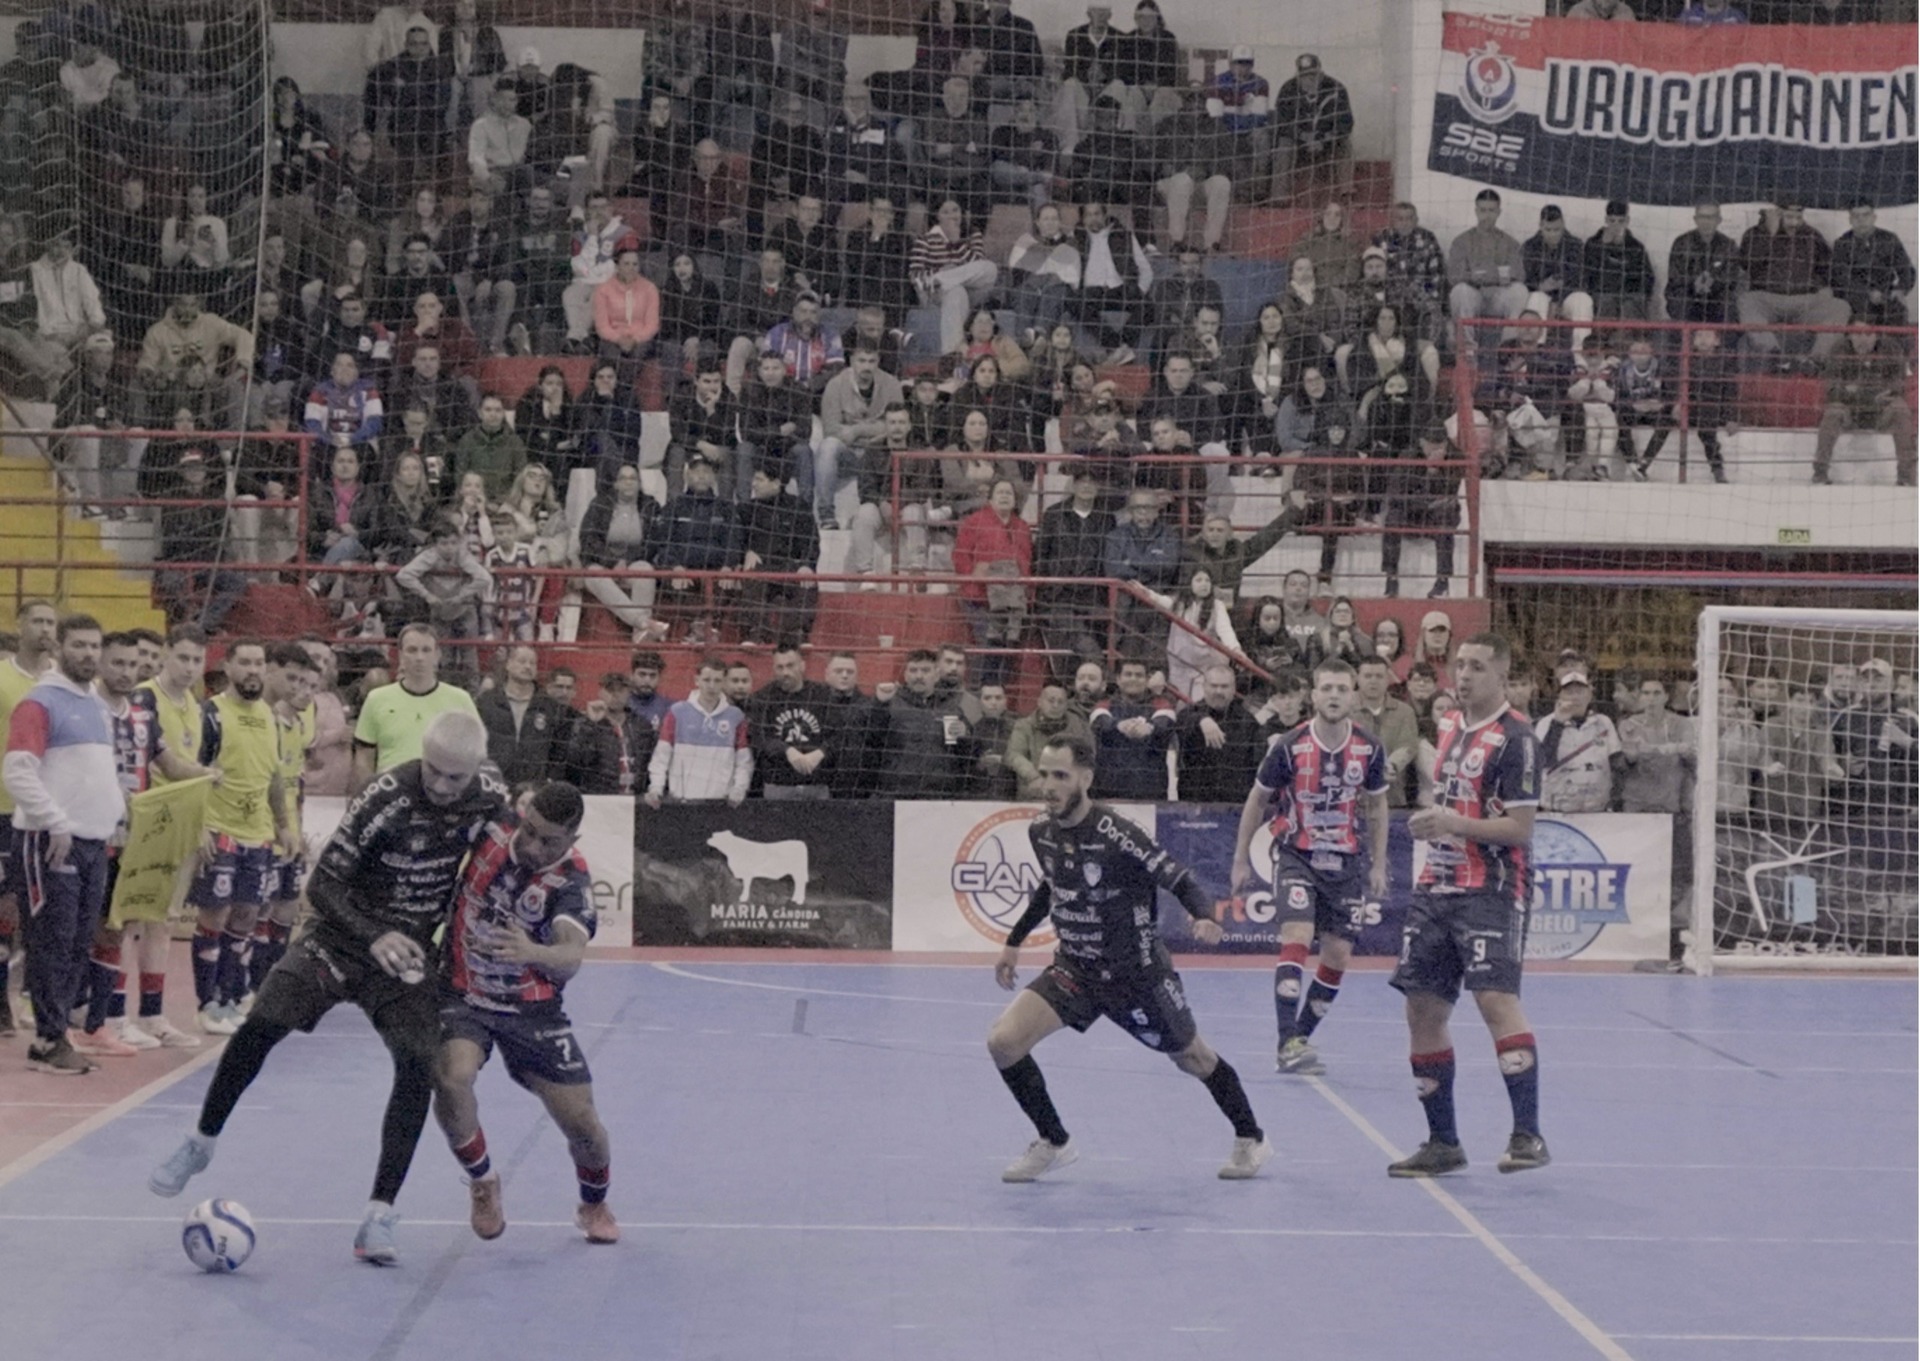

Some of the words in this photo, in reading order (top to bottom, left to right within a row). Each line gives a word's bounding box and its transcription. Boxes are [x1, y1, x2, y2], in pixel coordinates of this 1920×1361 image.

[1543, 61, 1917, 145] URUGUAIANEN
[1444, 122, 1524, 159] SBE
[1438, 145, 1517, 172] SPORTS
[711, 903, 768, 920] MARIA
[778, 920, 810, 930] FARM
[1474, 939, 1487, 963] 9
[1131, 1008, 1149, 1026] 5
[555, 1038, 571, 1063] 7
